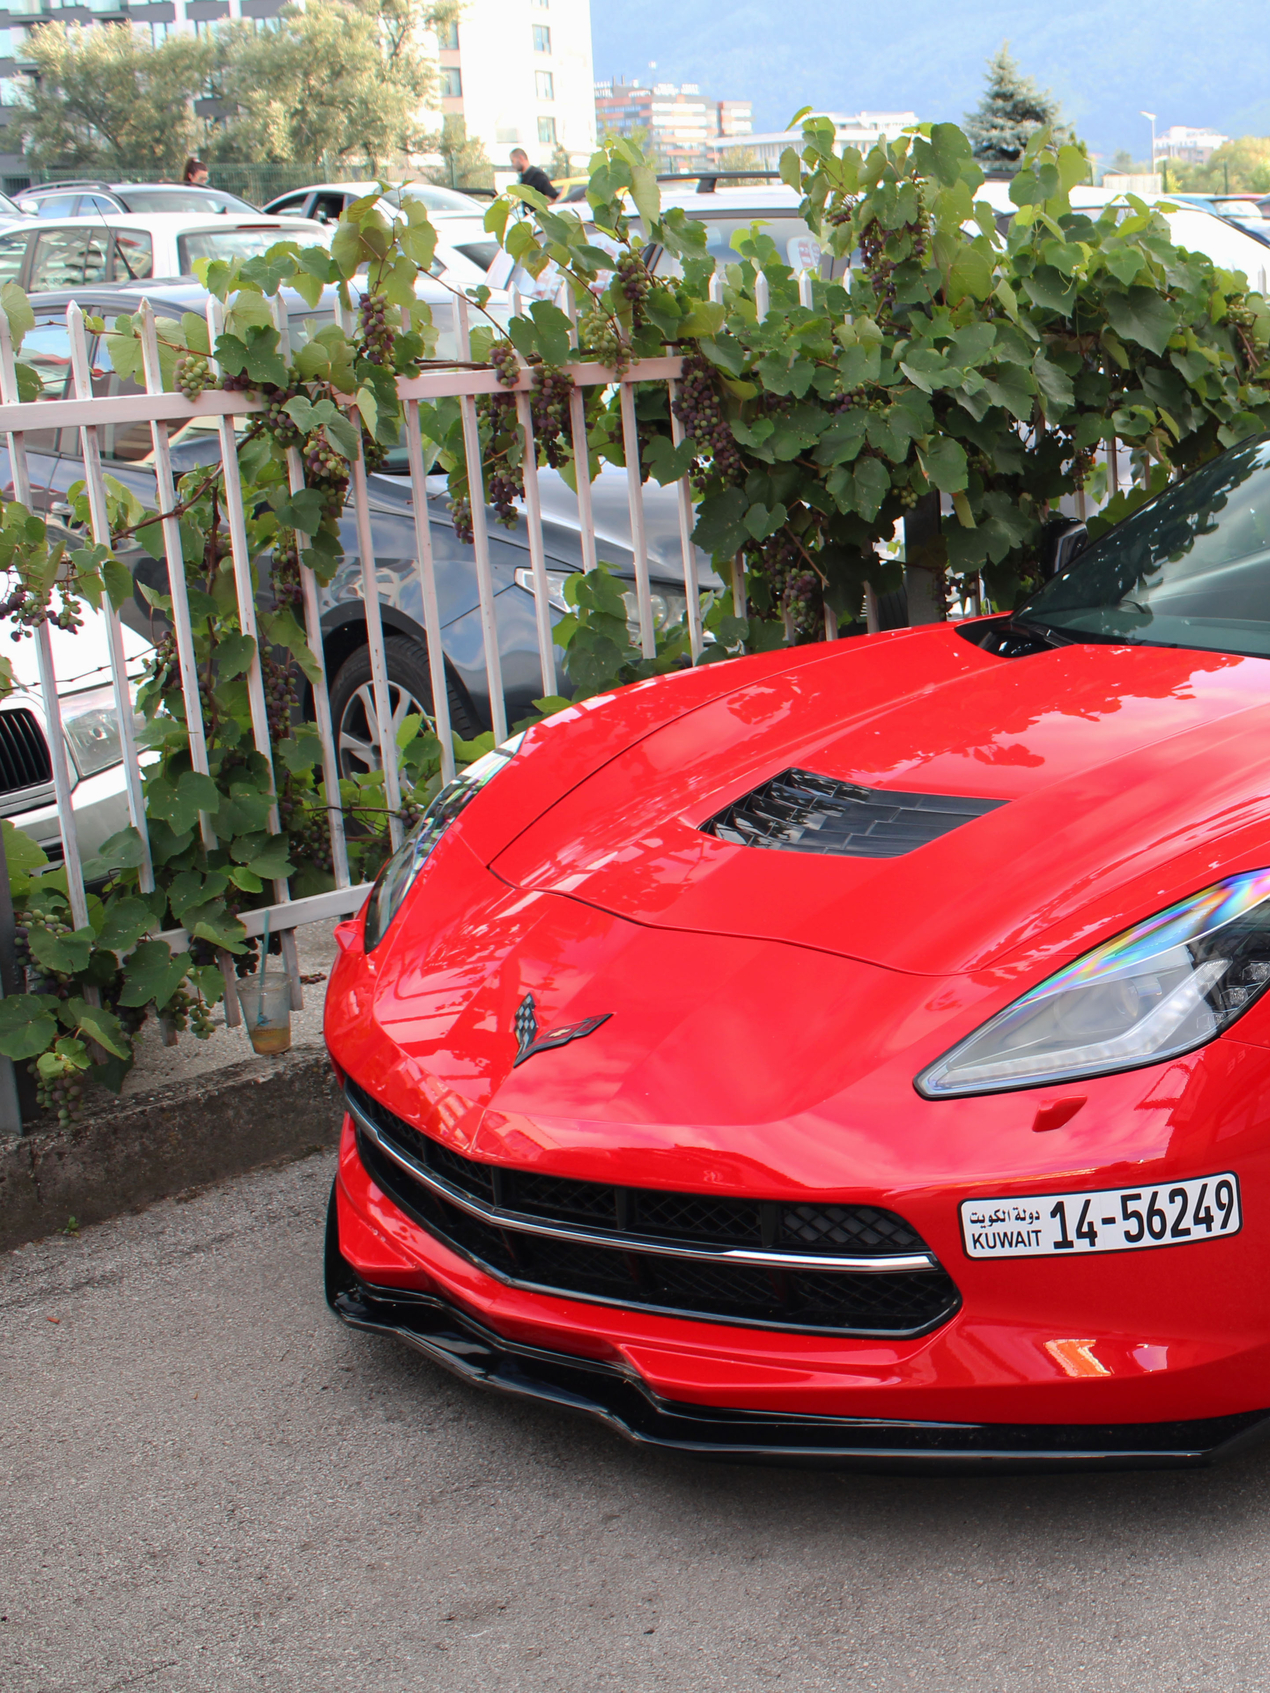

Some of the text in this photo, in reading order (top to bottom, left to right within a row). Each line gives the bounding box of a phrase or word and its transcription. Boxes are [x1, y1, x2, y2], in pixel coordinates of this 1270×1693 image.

[969, 1206, 1041, 1229] دولة الكويت
[1049, 1179, 1234, 1249] 14-56249
[971, 1229, 1042, 1250] KUWAIT
